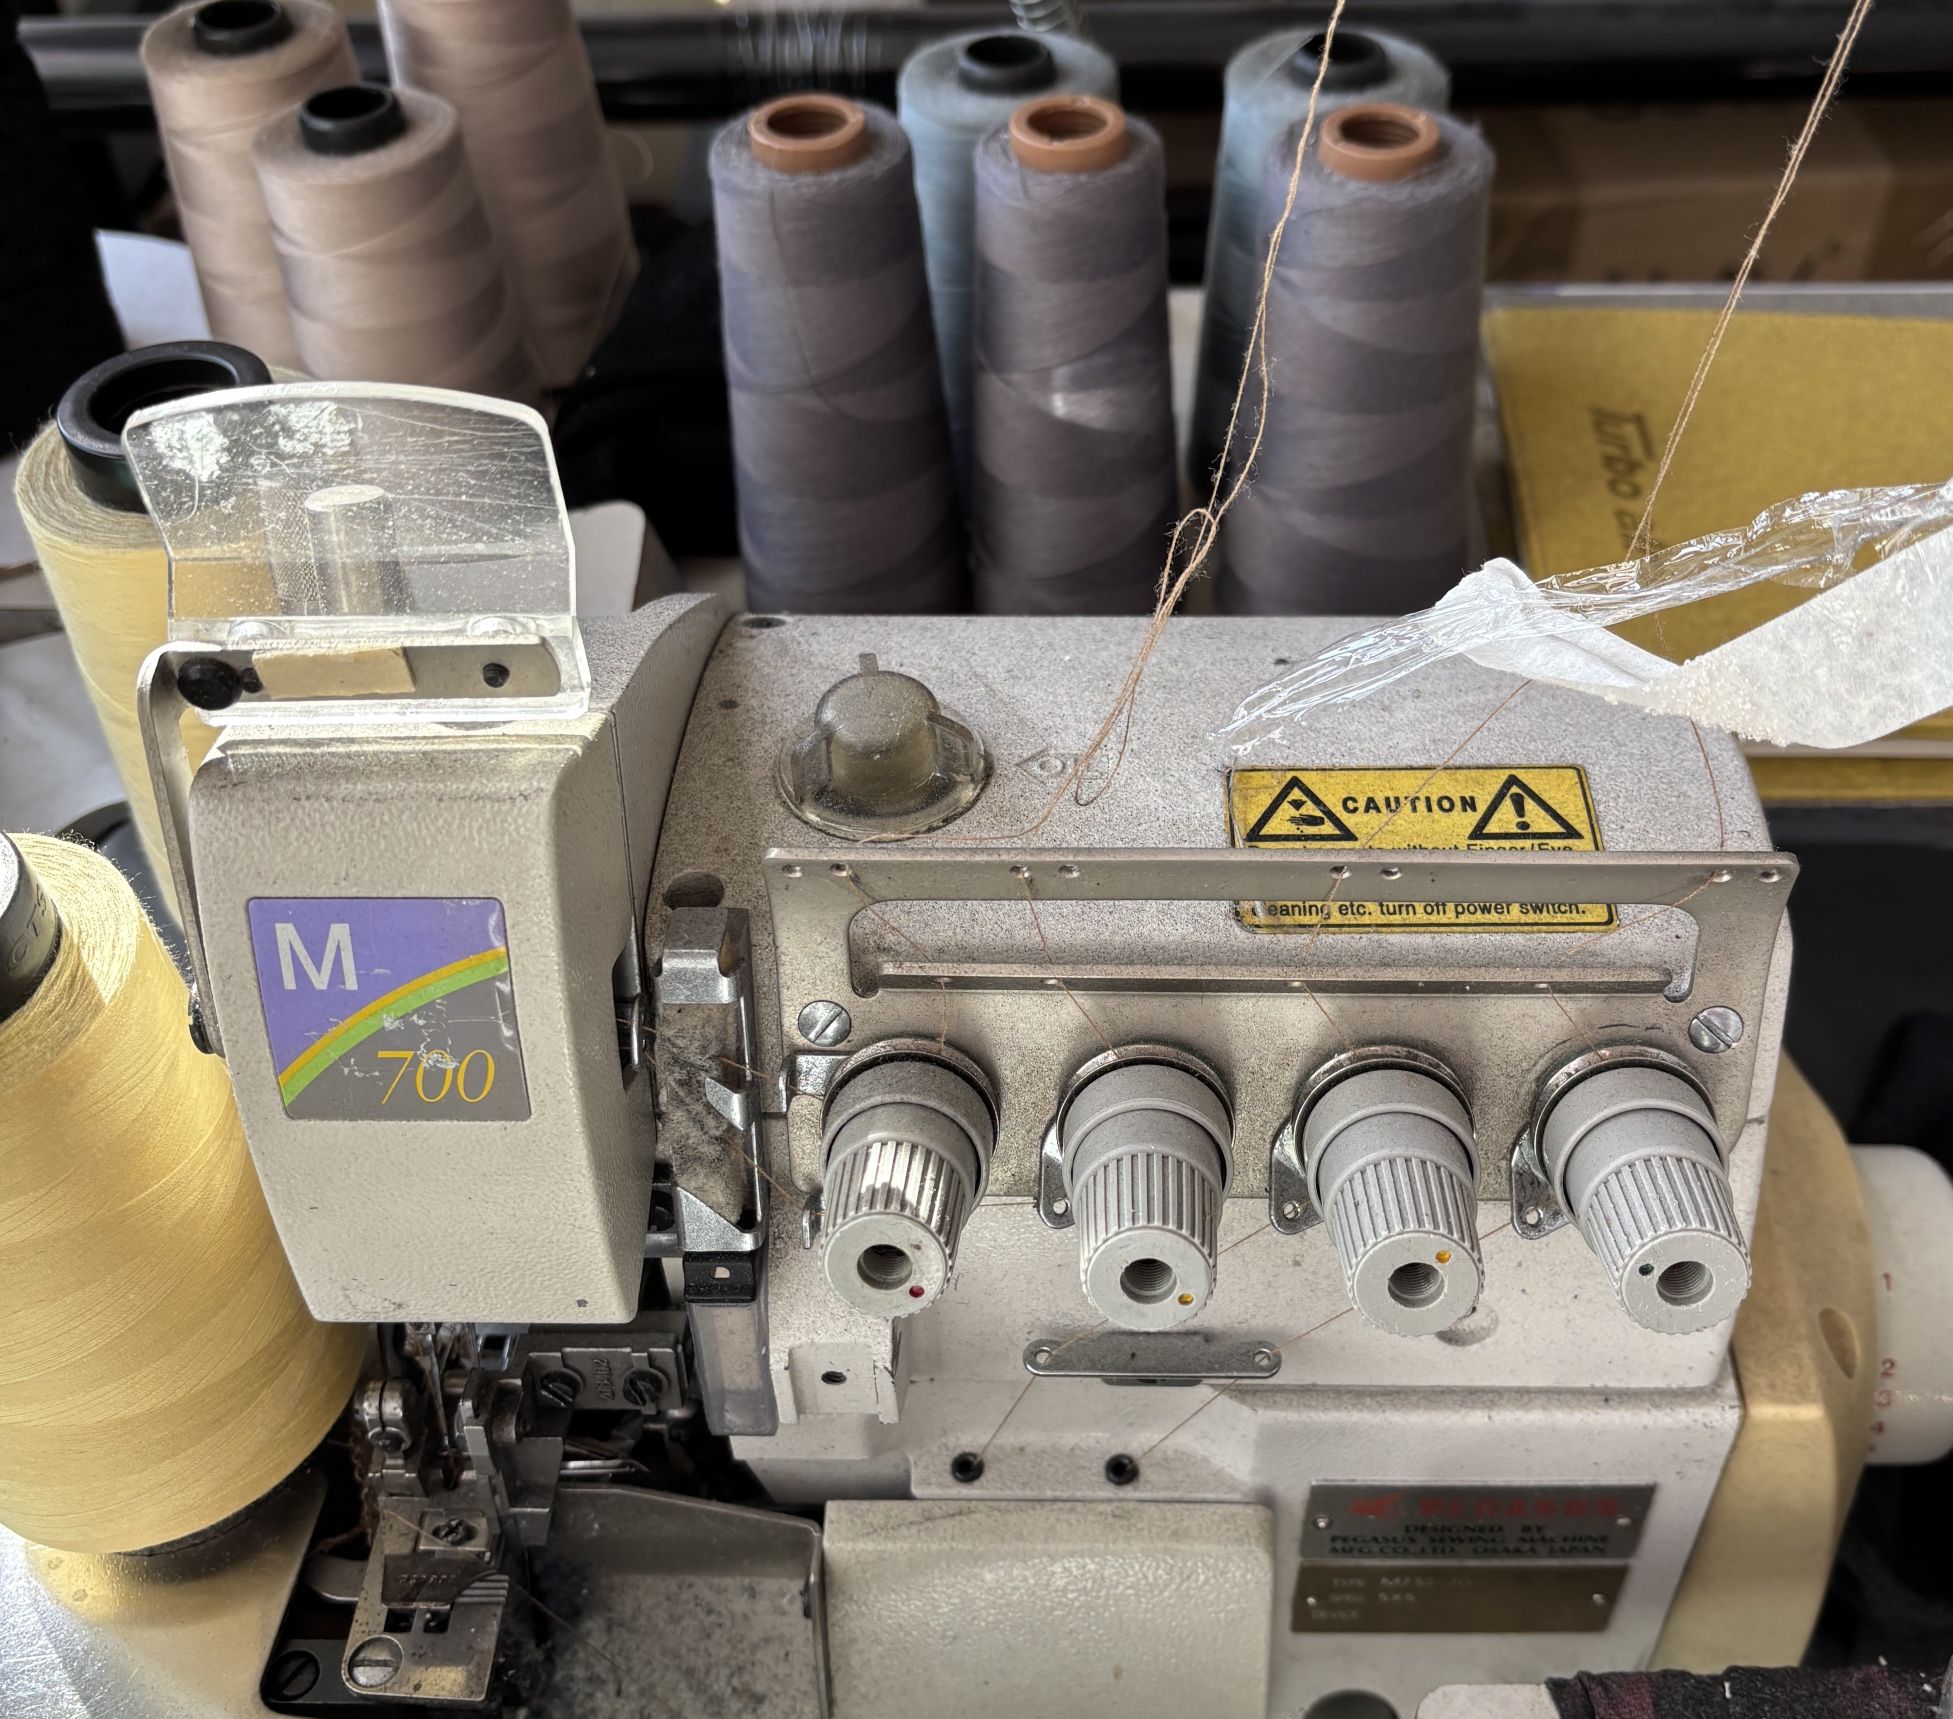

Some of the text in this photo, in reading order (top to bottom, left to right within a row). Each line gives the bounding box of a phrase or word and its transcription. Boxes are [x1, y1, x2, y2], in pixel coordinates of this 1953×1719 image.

[1341, 794, 1478, 814] CAUTION
[1338, 902, 1372, 916] etc.
[1379, 902, 1417, 916] turn
[1423, 903, 1447, 916] off
[1454, 903, 1512, 919] power
[1519, 904, 1586, 916] switch.
[274, 923, 358, 990] M
[377, 1049, 496, 1105] 700
[1880, 1358, 1896, 1377] 2
